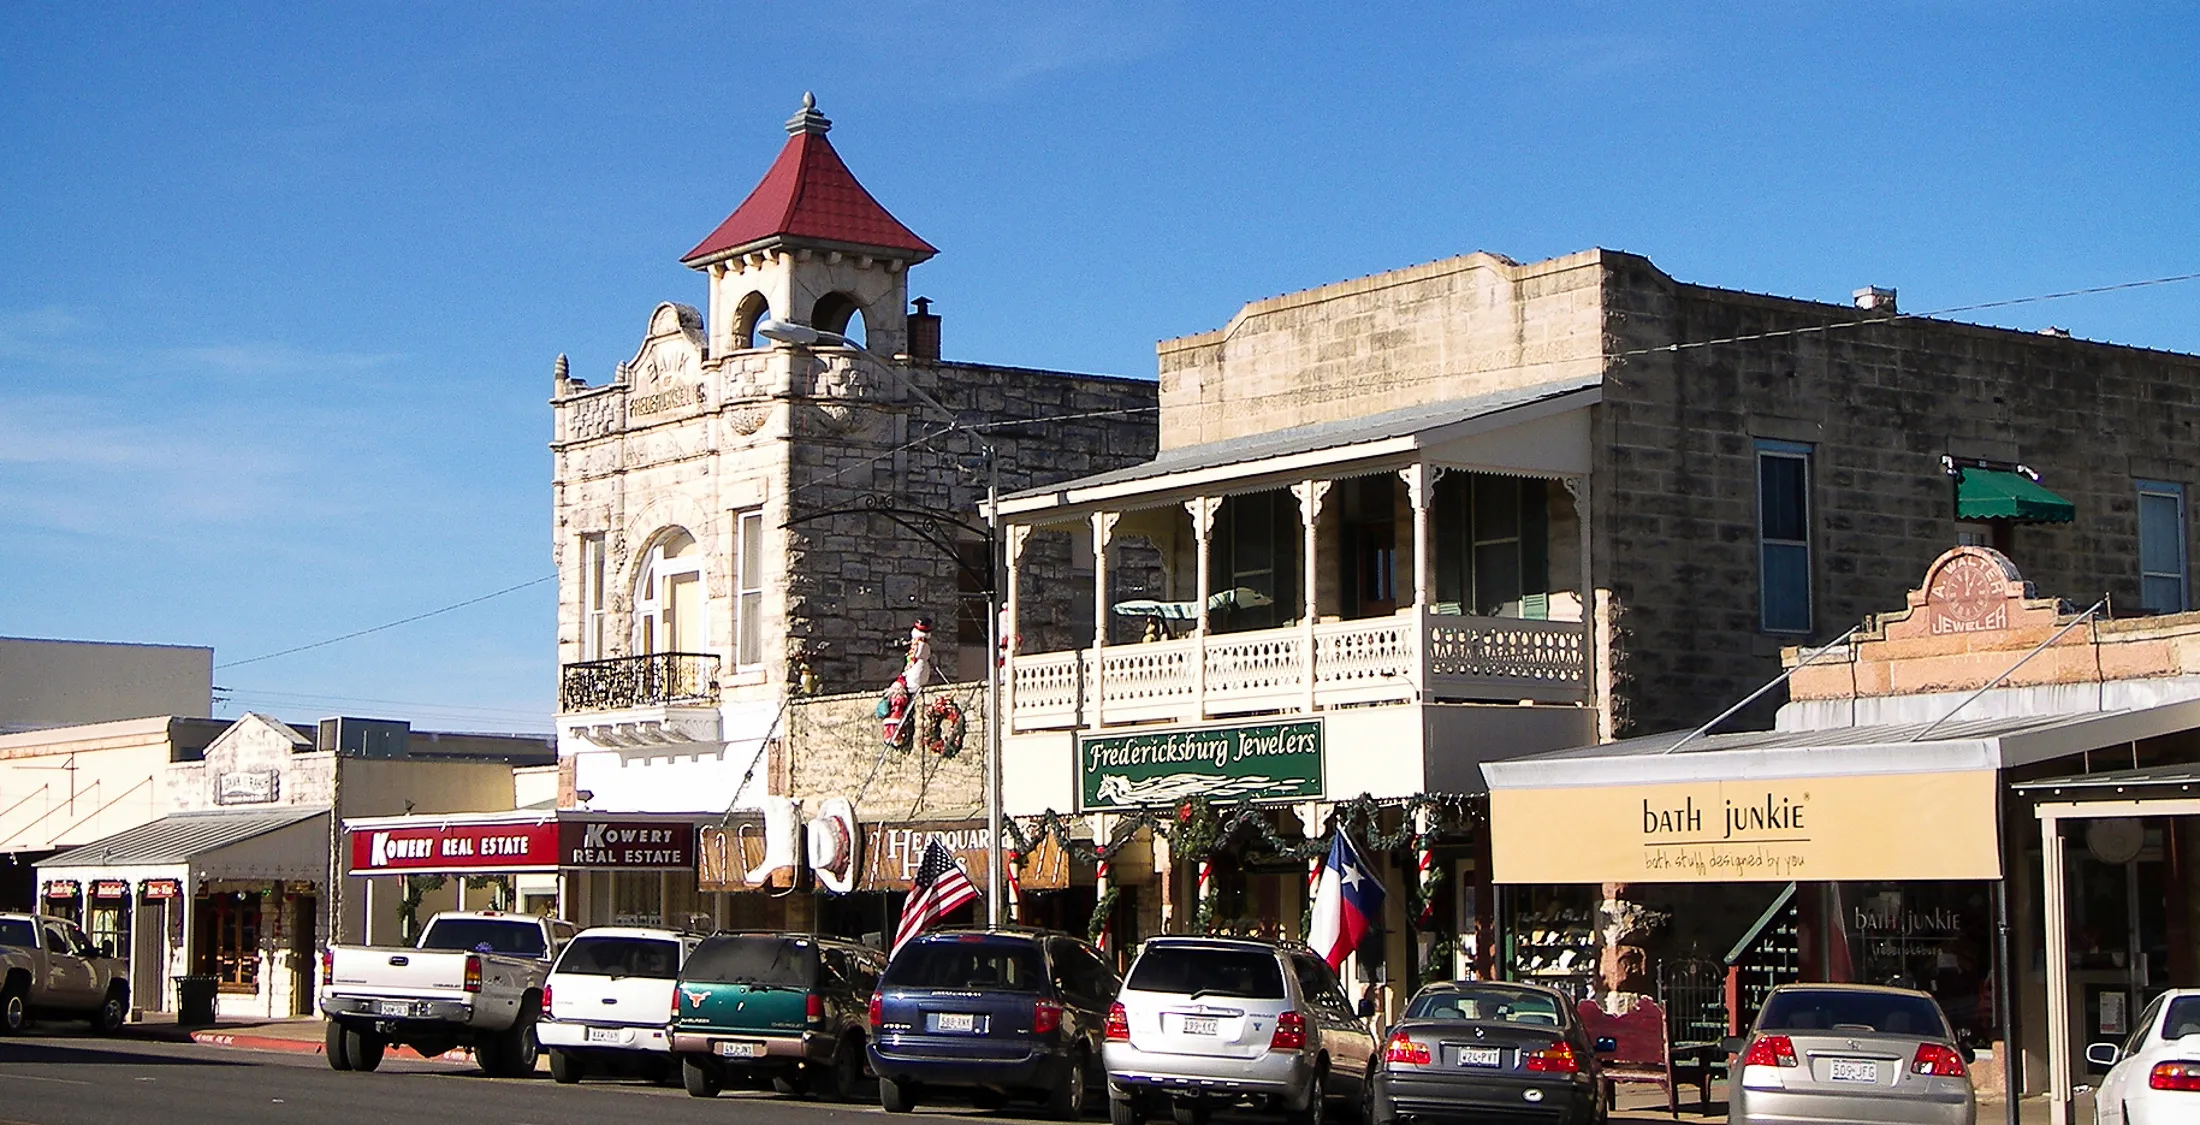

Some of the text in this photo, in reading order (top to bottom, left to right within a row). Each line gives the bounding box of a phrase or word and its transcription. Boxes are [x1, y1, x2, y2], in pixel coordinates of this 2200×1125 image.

[1943, 555, 2005, 595] WALTER
[1932, 602, 2007, 635] JEWELER
[1088, 725, 1316, 773] Fredericksburg Jewelers
[371, 831, 529, 867] KOWERT REAL ESTATE
[583, 823, 673, 849] KOWERT
[573, 848, 682, 864] REAL ESTATE
[1709, 846, 1763, 877] designed
[1766, 848, 1780, 875] by
[1784, 855, 1805, 876] you
